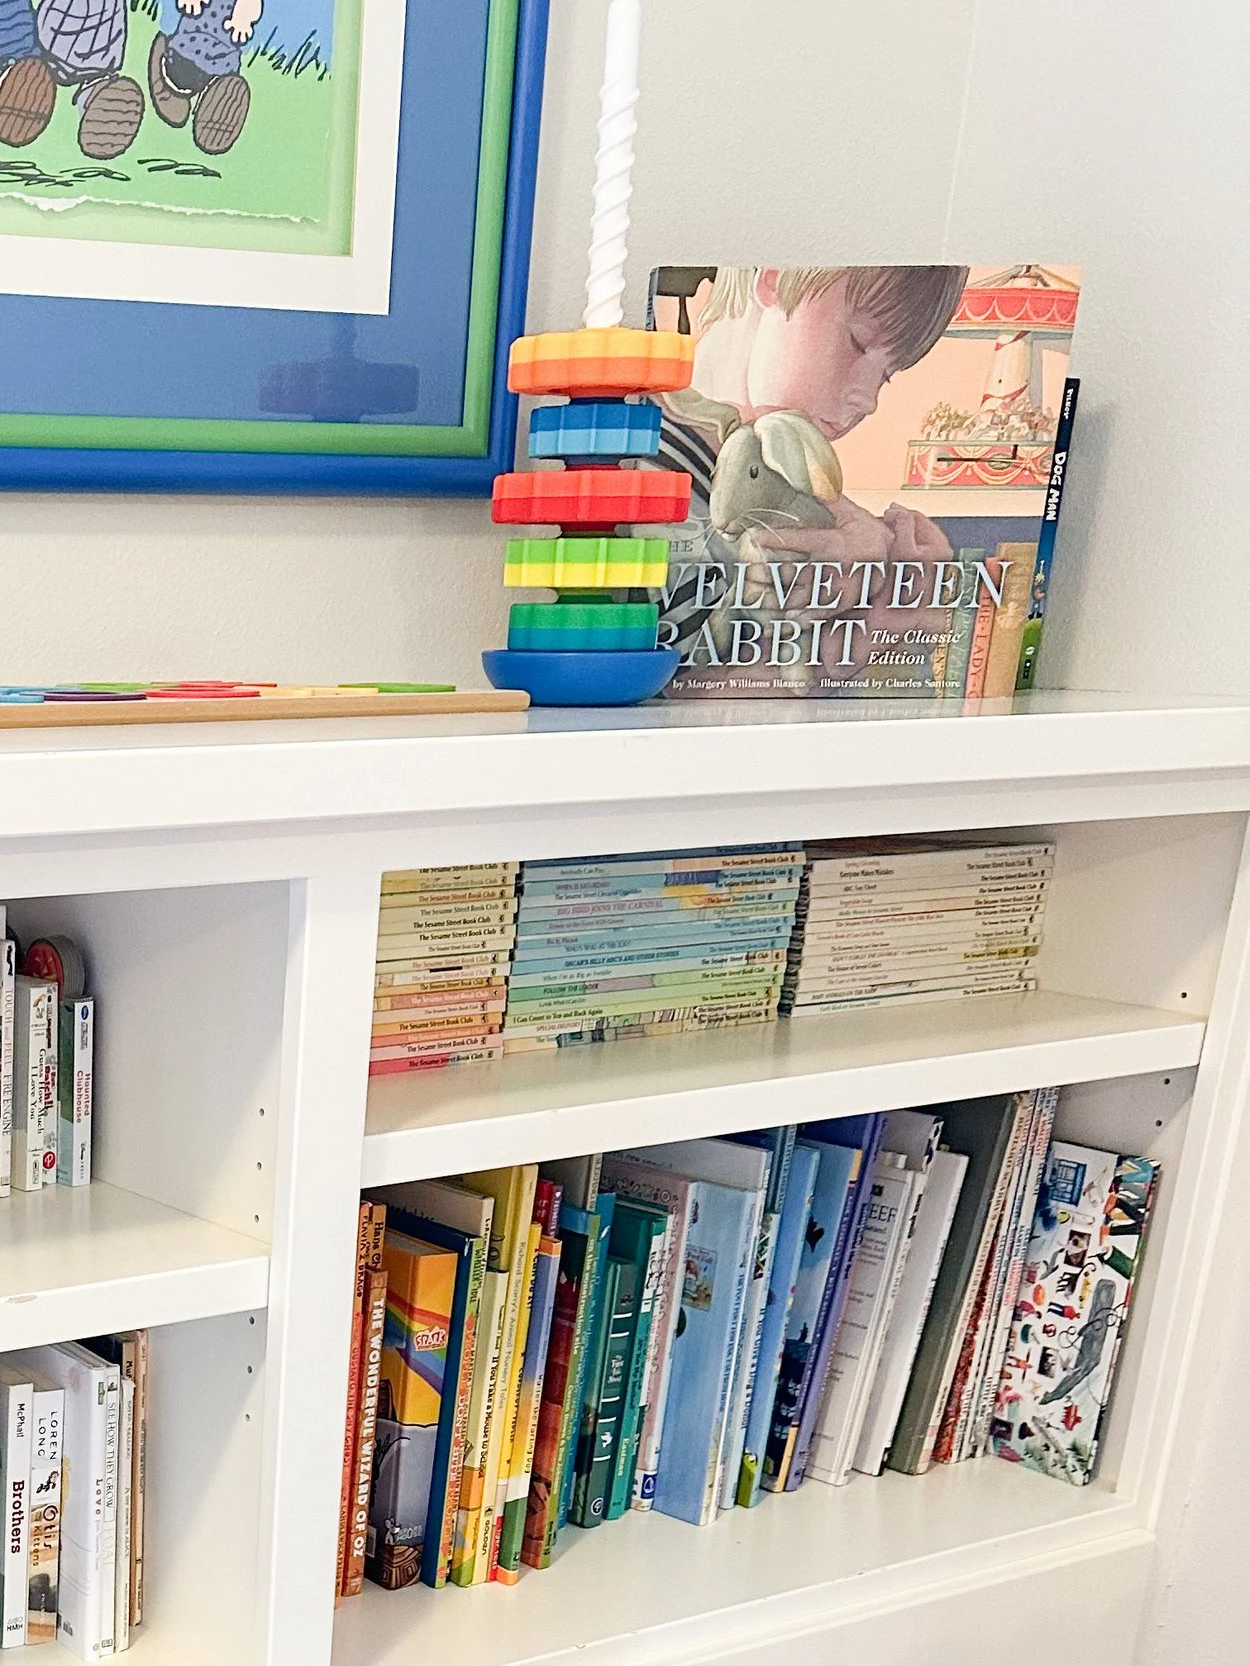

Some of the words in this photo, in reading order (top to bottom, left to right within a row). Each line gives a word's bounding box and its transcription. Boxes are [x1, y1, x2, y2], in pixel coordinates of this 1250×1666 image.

[1054, 452, 1067, 485] DOG
[1045, 490, 1060, 521] MAN
[669, 541, 694, 552] HE
[660, 562, 1014, 610] VELVETEEN
[871, 629, 900, 644] The
[904, 629, 962, 644] Classic
[868, 651, 926, 665] Edition
[672, 679, 684, 691] by
[687, 679, 726, 691] Margery
[729, 678, 770, 688] Williams
[773, 679, 805, 688] Bianco
[820, 678, 869, 688] Illustrated
[872, 679, 883, 689] by
[886, 678, 922, 687] Charles
[925, 679, 960, 687] Santore
[76, 1070, 84, 1124] Clubhouse
[372, 1300, 384, 1329] THE
[415, 1330, 446, 1346] SPARK
[362, 1334, 383, 1438] WONDERFUL
[37, 1417, 46, 1457] LONG
[50, 1411, 59, 1460] LOREN
[358, 1441, 373, 1507] WIZARD
[11, 1480, 25, 1554] Brothers
[355, 1511, 366, 1532] OF
[353, 1536, 365, 1558] OZ
